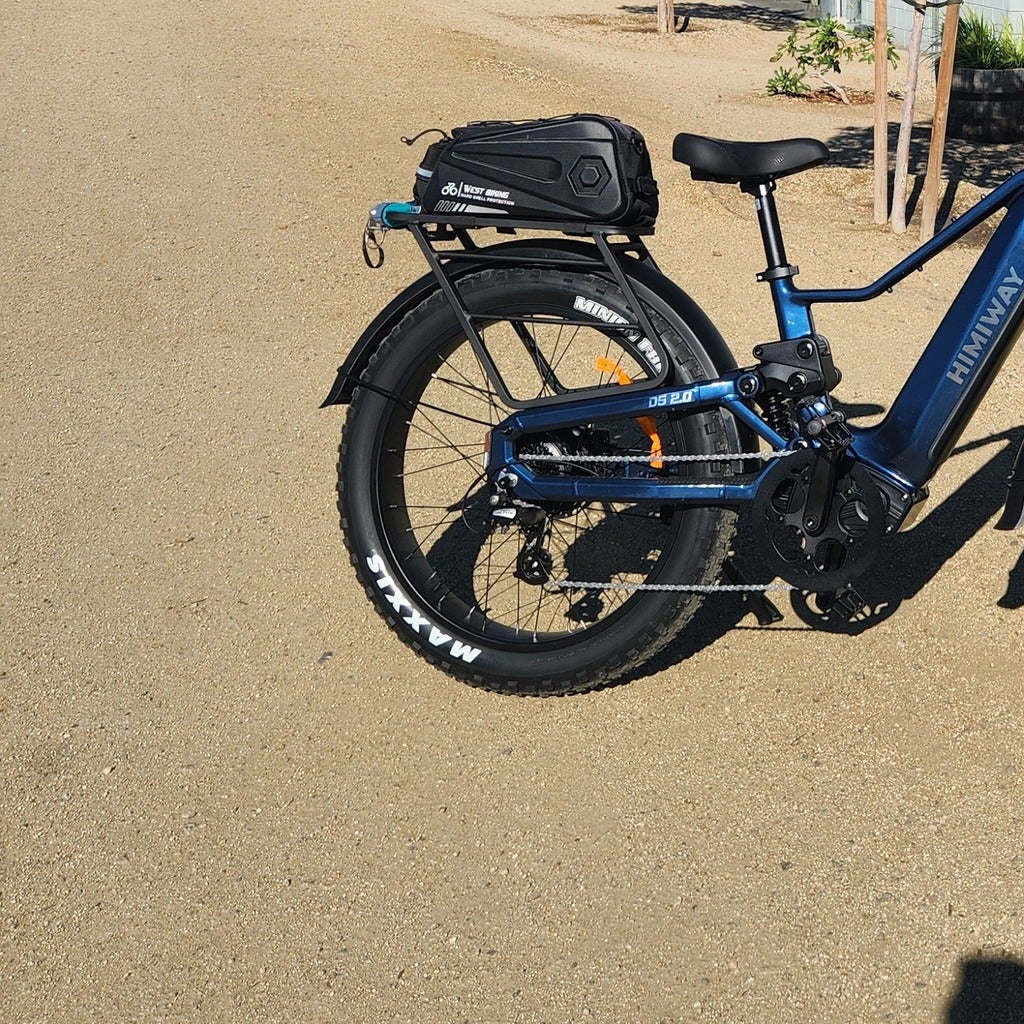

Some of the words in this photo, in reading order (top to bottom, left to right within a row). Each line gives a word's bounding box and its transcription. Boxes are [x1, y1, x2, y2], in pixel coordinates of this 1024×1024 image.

[463, 184, 485, 194] WEST
[947, 266, 1024, 385] HIMIWAY
[670, 389, 693, 405] 2.0
[366, 552, 481, 663] MAXXIS
